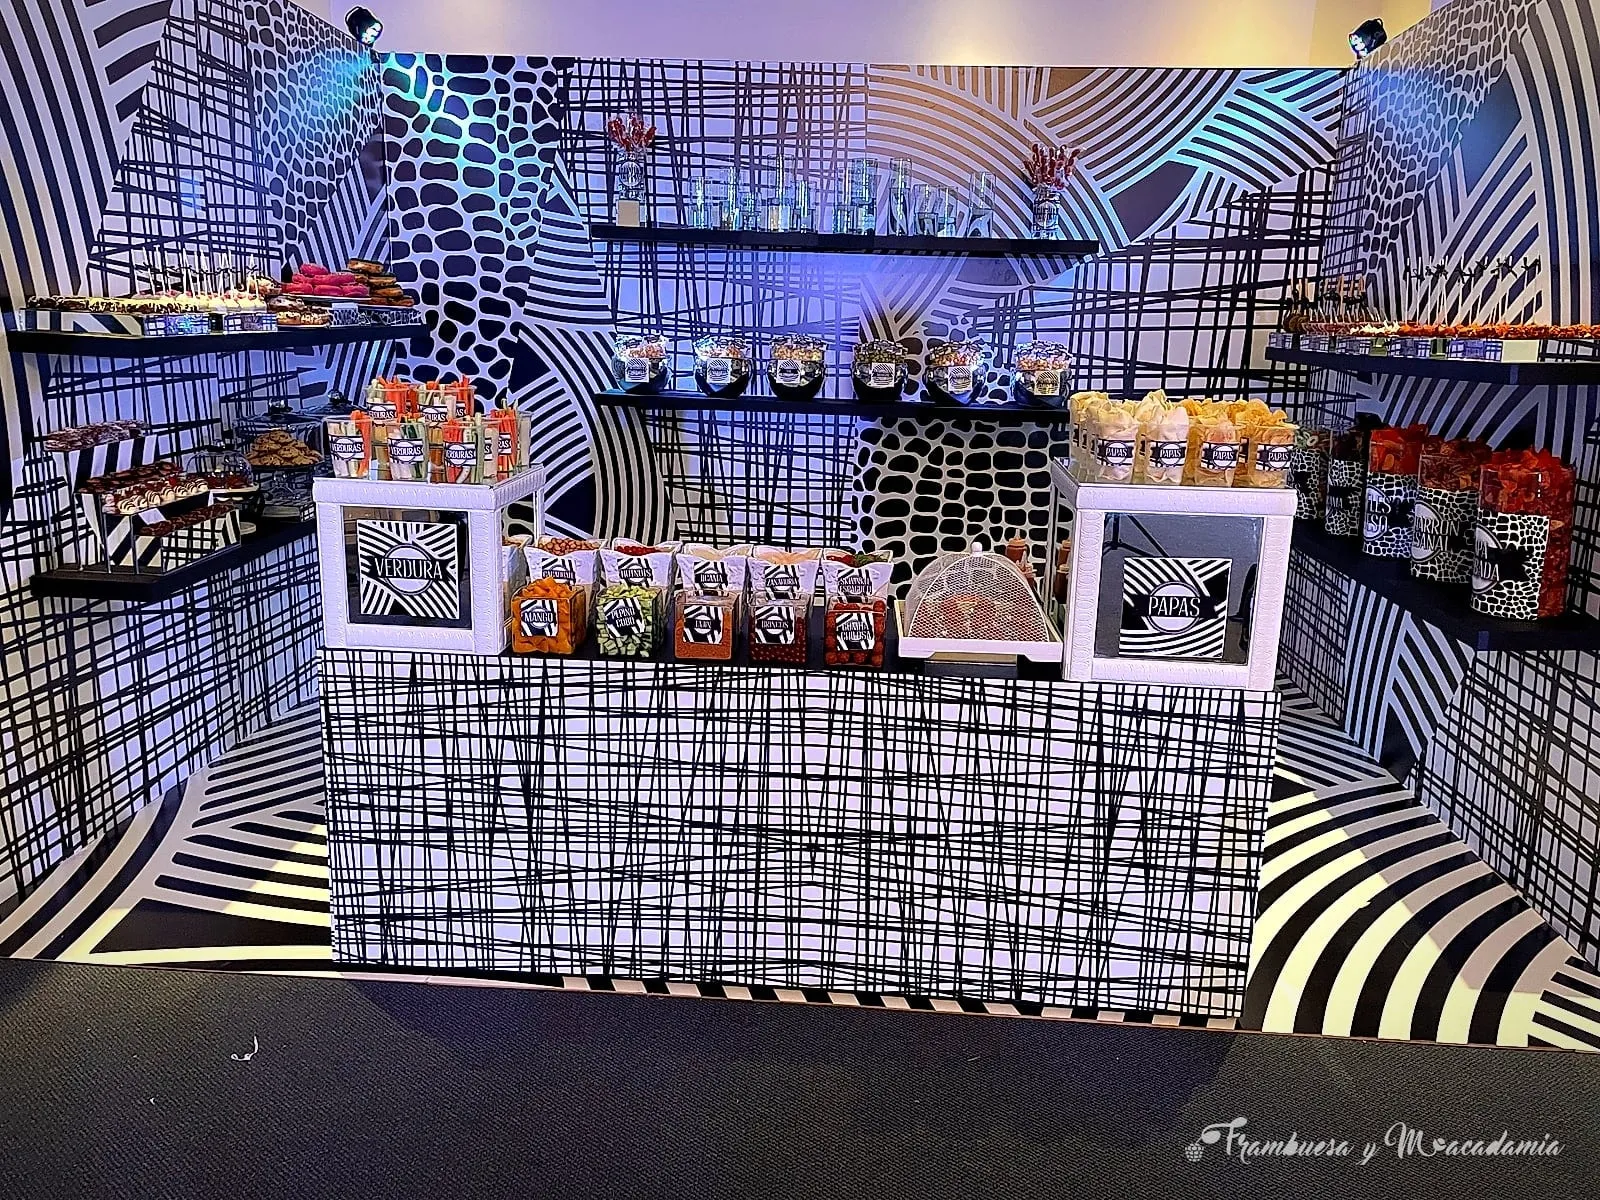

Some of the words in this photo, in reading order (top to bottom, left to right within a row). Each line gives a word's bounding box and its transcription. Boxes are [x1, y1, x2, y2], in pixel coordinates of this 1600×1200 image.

[331, 443, 362, 453] VERDURAS
[391, 445, 421, 455] VERDURAS
[1105, 447, 1128, 457] PAPAS
[1160, 449, 1182, 458] PAPAS
[1212, 451, 1234, 460] PAPAS
[1268, 452, 1289, 461] PAPAS
[374, 557, 443, 579] VERDURA
[1148, 596, 1201, 617] PAPAS
[524, 612, 554, 623] MANGO
[611, 607, 635, 620] PEPINO
